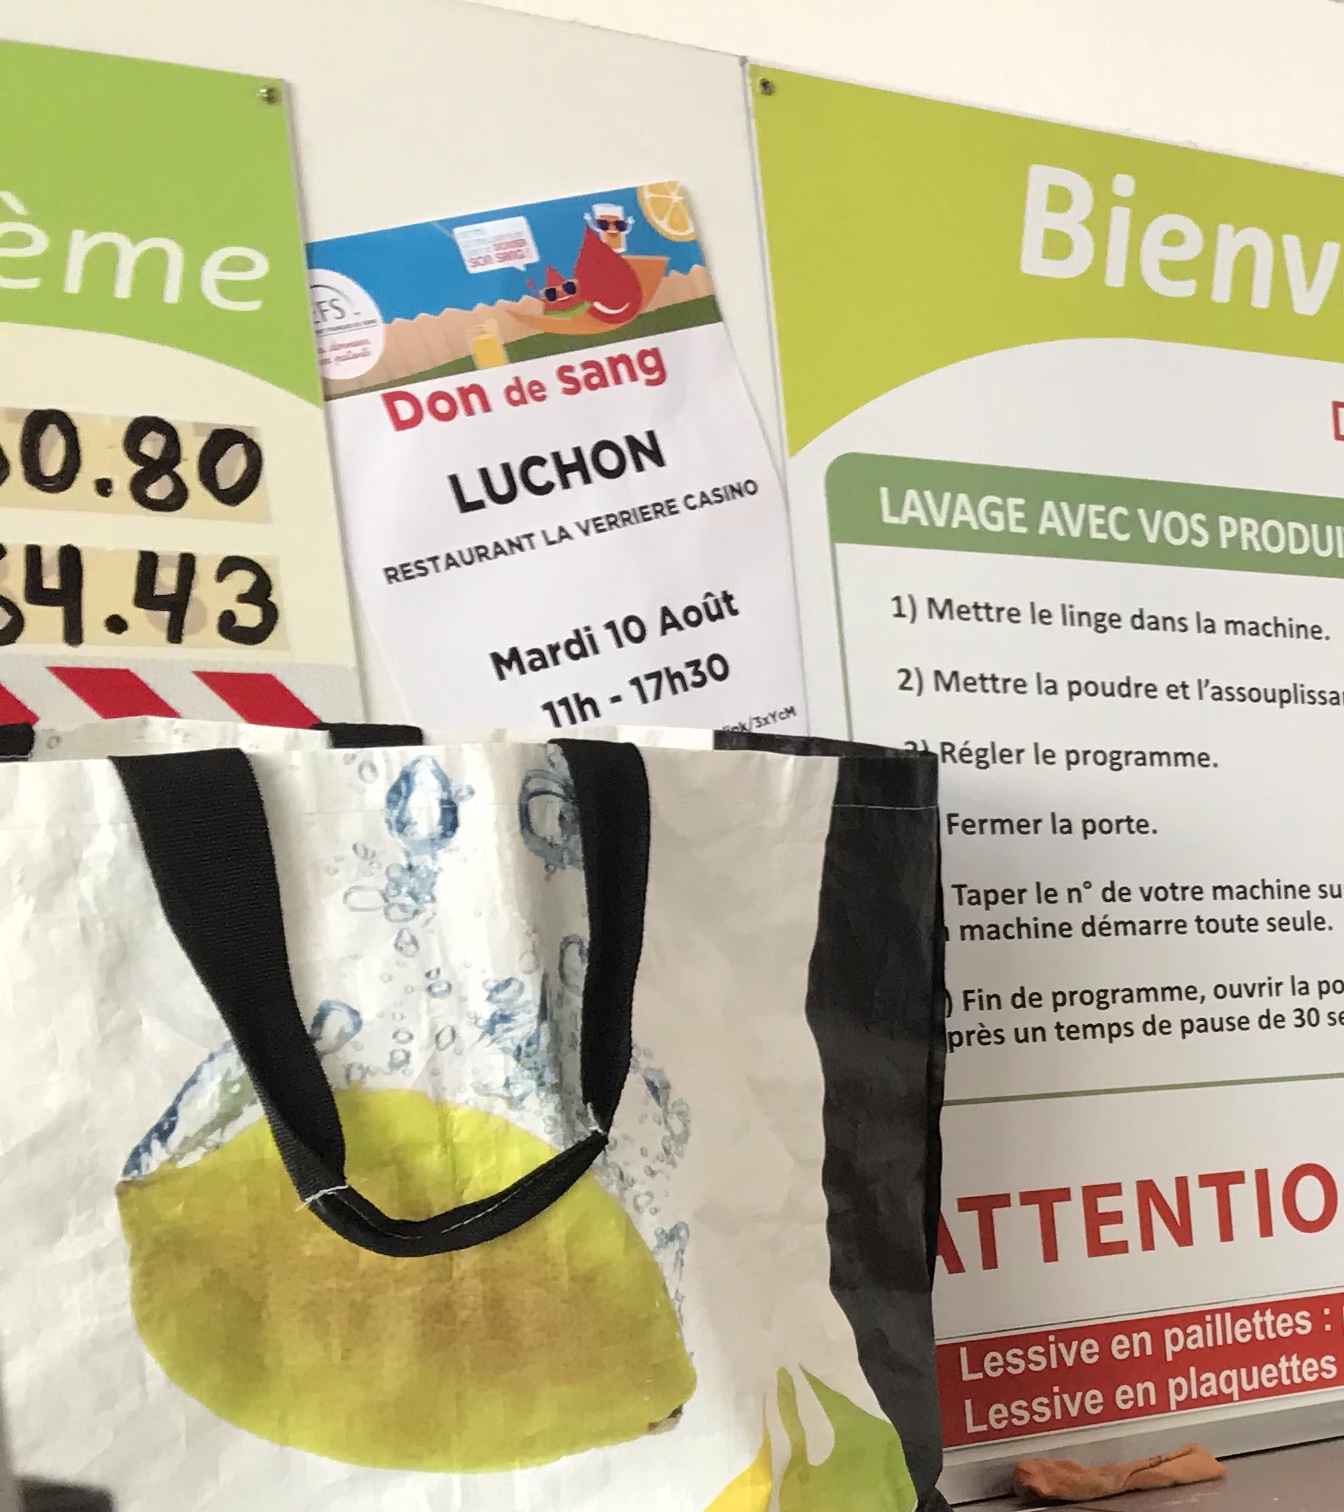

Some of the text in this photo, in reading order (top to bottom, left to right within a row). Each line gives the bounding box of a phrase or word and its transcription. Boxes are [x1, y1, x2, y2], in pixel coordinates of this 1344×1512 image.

[381, 384, 492, 431] Don
[504, 376, 547, 406] de
[0, 409, 263, 512] 0.80
[448, 430, 667, 518] LUCHON
[384, 479, 758, 584] RESTAURANT LA VERRIERE CASINO
[880, 487, 1028, 533] LAVAGE
[1038, 501, 1130, 541] AVEC
[1138, 509, 1209, 547] VOS
[490, 590, 739, 680] Mardi 10 Août
[892, 594, 1330, 640] 1) Mettre le linge dans la machine.
[542, 693, 600, 728] 11h
[629, 654, 729, 704] 17h30
[898, 667, 923, 696] 2)
[934, 670, 1028, 694] Mettre
[1036, 672, 1058, 695] la
[1068, 676, 1157, 701] poudre
[1166, 681, 1190, 700] et
[941, 741, 1218, 771] Régler le programme.
[951, 884, 1027, 910] Taper
[1036, 882, 1058, 904] le
[1067, 881, 1092, 903] n°
[1102, 880, 1131, 902] de
[1139, 883, 1204, 902] votre
[1212, 879, 1310, 900] machine
[960, 1335, 1099, 1380] Lessive
[1112, 1332, 1152, 1359] en
[1165, 1308, 1312, 1361] paillettes
